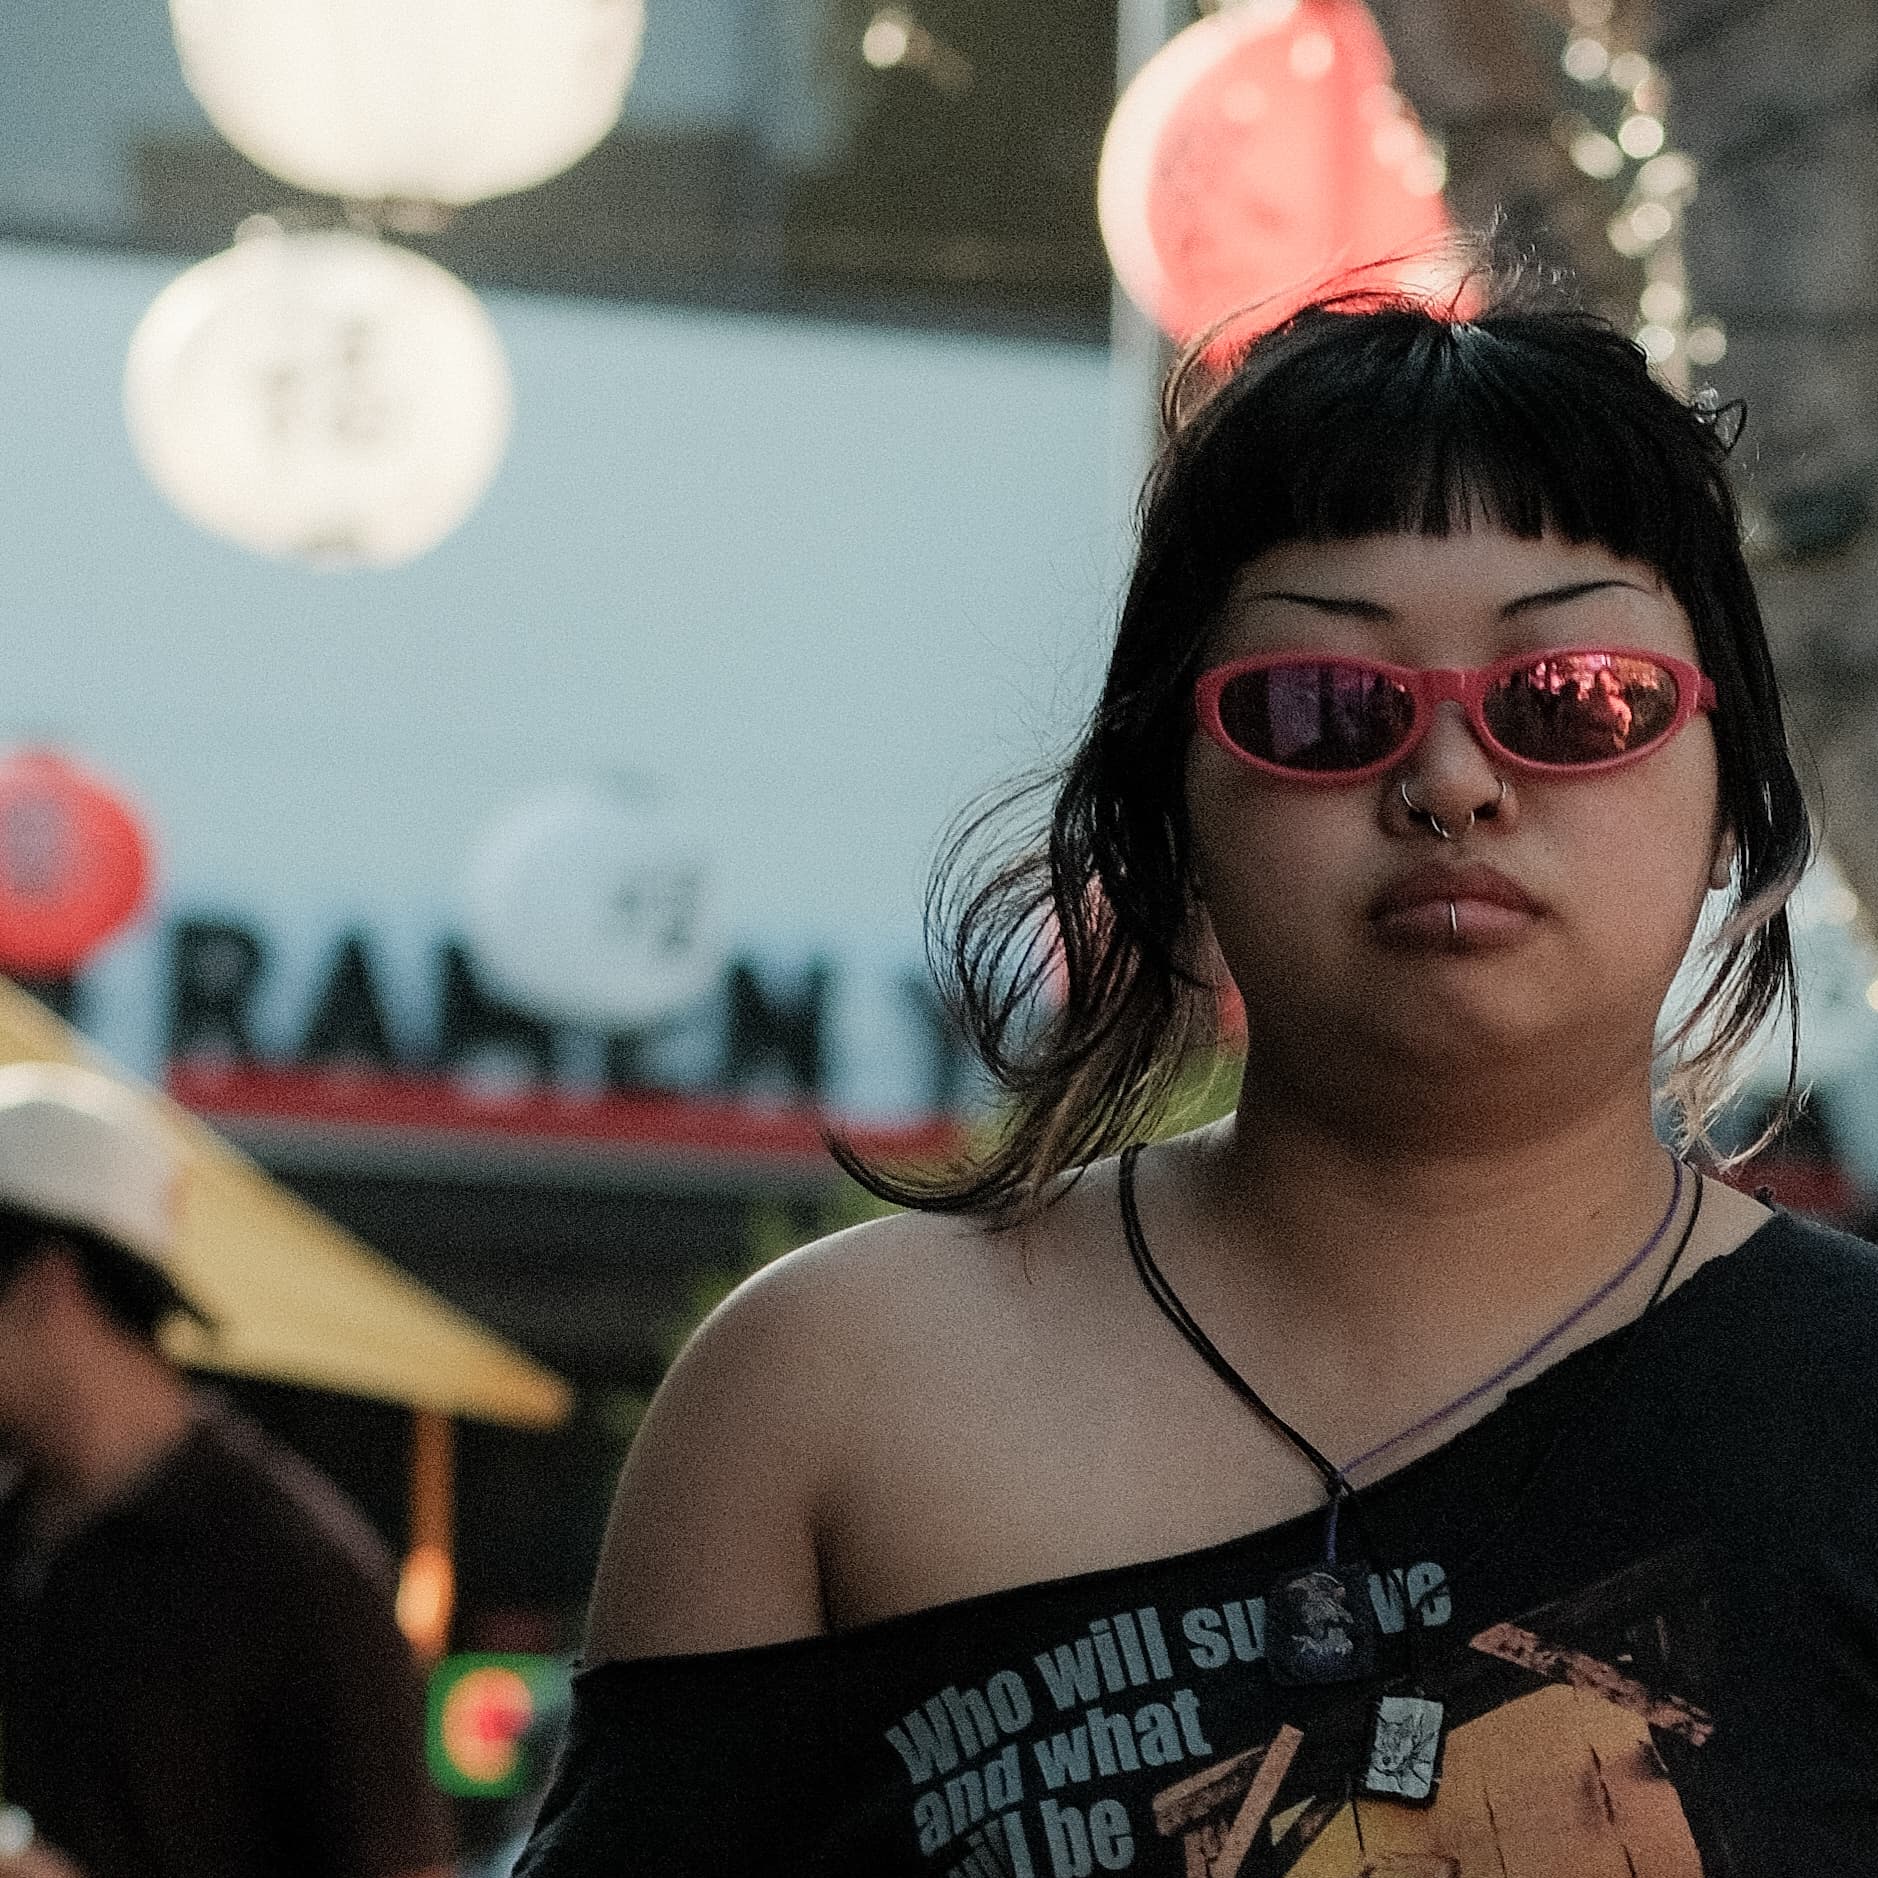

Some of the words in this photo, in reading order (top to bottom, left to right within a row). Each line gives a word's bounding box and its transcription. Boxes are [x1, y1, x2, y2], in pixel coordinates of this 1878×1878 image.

[885, 1670, 1033, 1786] Who
[1033, 1606, 1174, 1711] will
[1182, 1560, 1453, 1671] suve
[913, 1742, 1025, 1856] and
[1035, 1688, 1212, 1792] what
